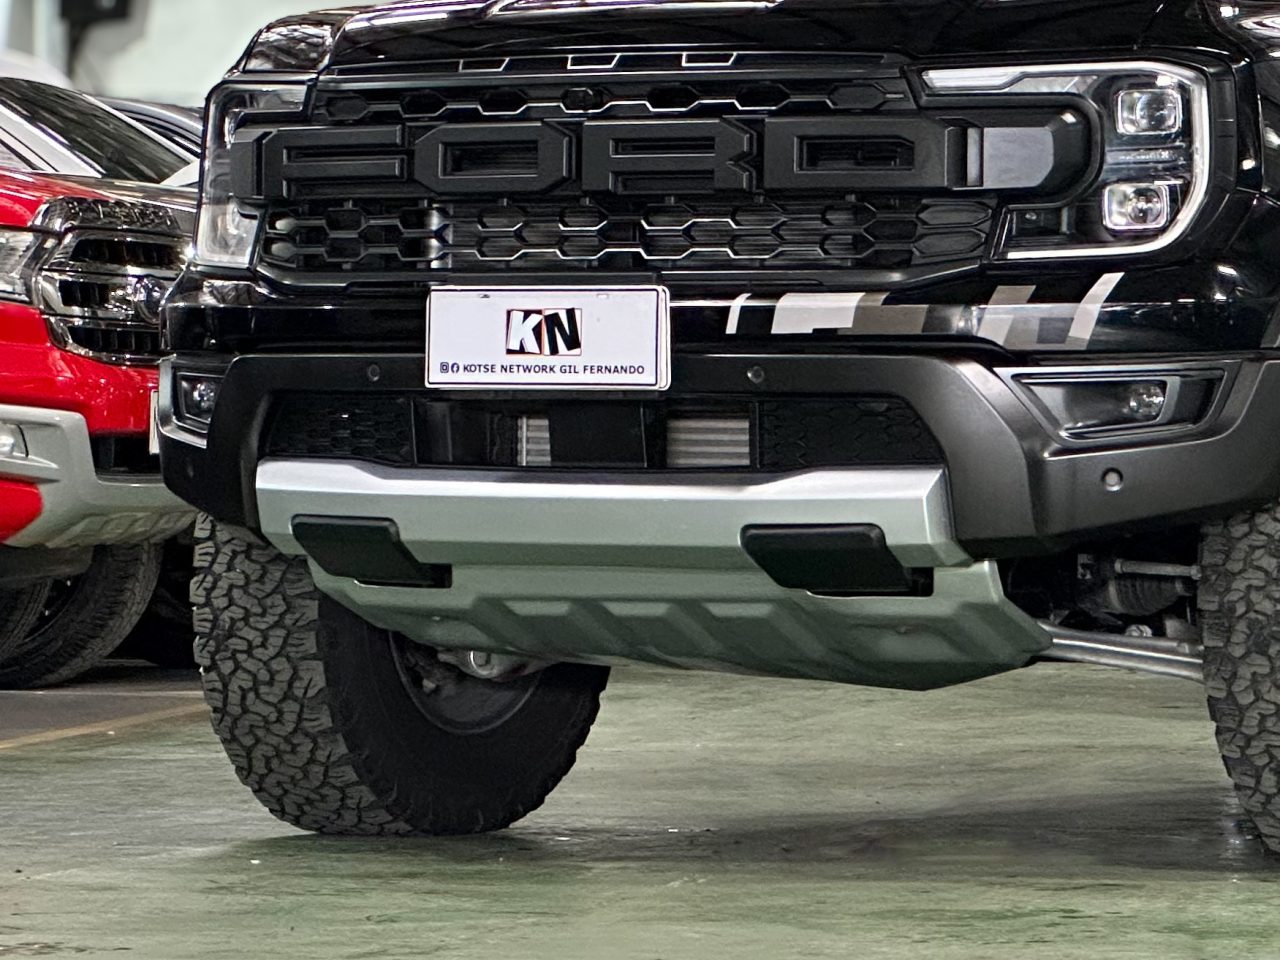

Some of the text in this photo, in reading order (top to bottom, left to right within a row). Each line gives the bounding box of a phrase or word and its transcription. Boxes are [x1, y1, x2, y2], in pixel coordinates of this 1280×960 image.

[236, 116, 950, 198] FORD
[506, 308, 582, 355] KN
[463, 364, 645, 375] KOTSE NETWORK GIL FERNANDO
